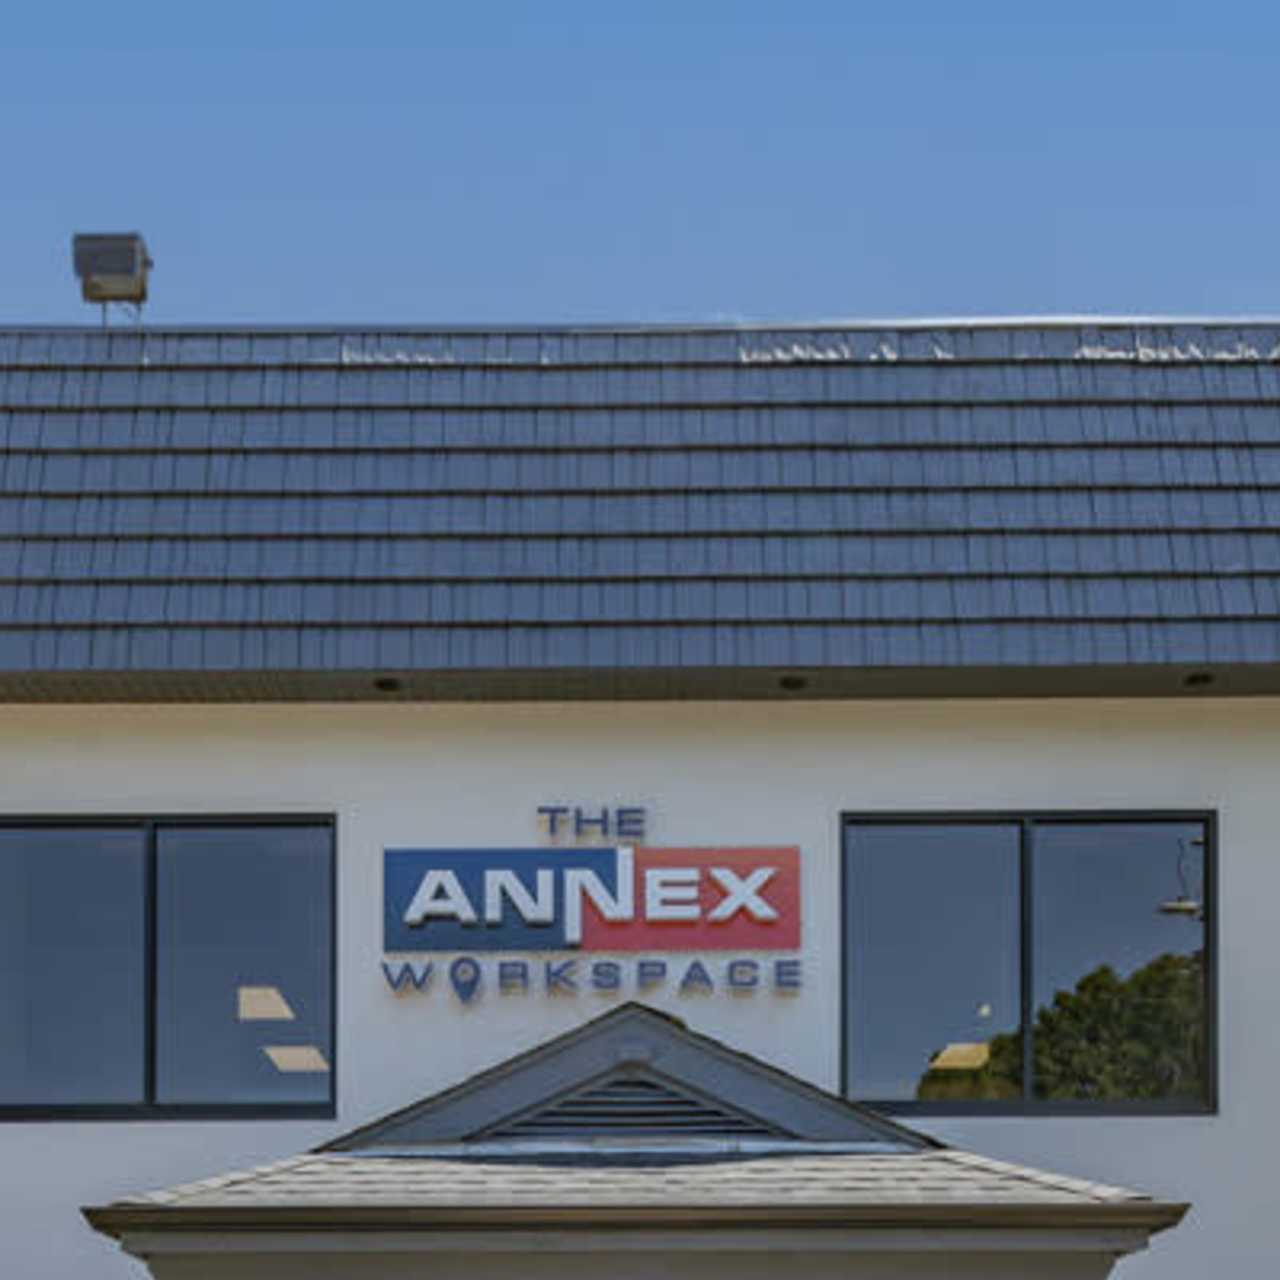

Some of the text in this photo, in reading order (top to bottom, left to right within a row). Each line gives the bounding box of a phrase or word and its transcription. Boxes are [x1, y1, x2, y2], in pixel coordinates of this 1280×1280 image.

[537, 805, 647, 838] THE
[403, 846, 780, 943] ANNEX
[382, 957, 804, 1002] WORKSPACE
